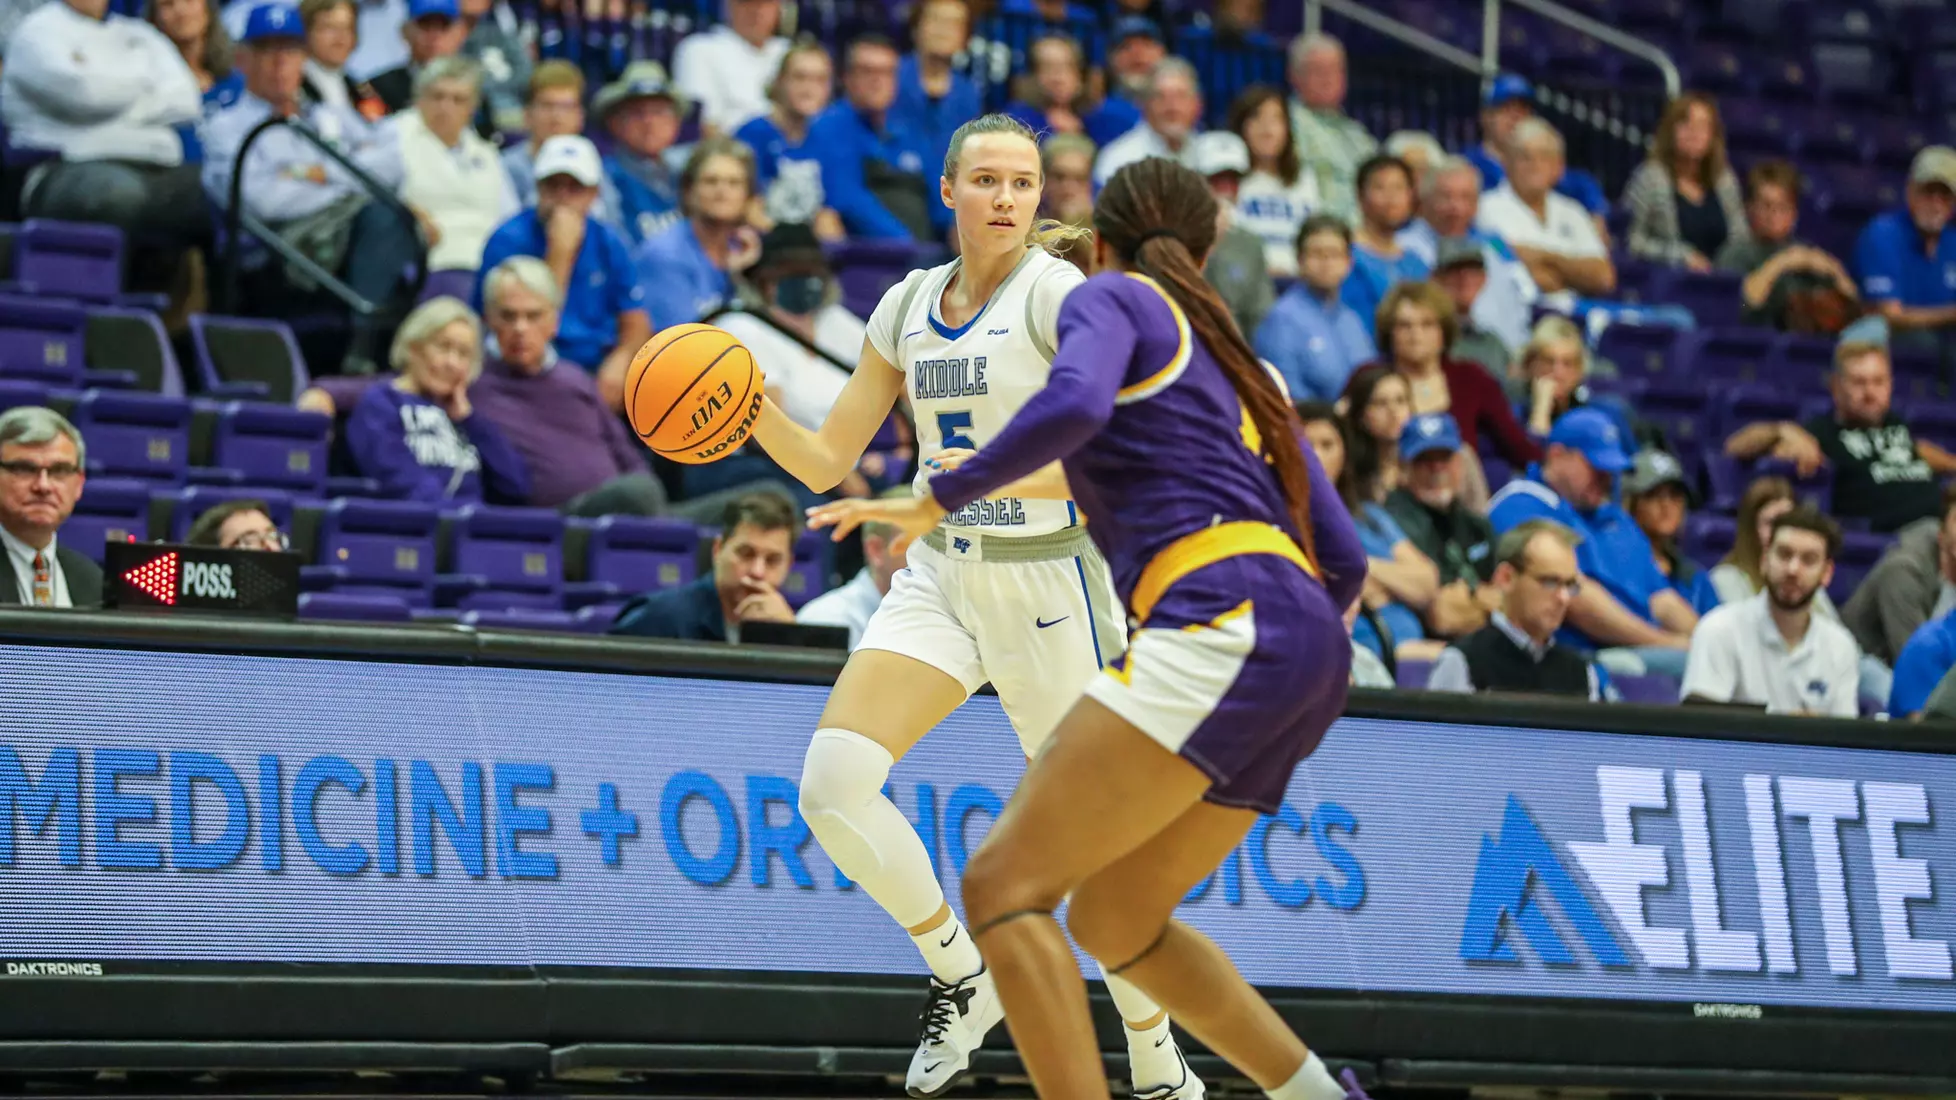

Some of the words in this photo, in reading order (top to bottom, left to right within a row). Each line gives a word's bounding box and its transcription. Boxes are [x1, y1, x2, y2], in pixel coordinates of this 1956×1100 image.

[914, 356, 988, 400] MIDDLE
[935, 409, 977, 451] 5
[943, 497, 1026, 527] ESSEE
[182, 561, 237, 599] POSS.
[0, 744, 559, 880] MEDICINE
[1567, 764, 1953, 980] ELITE
[6, 962, 103, 976] DAKTRONICS
